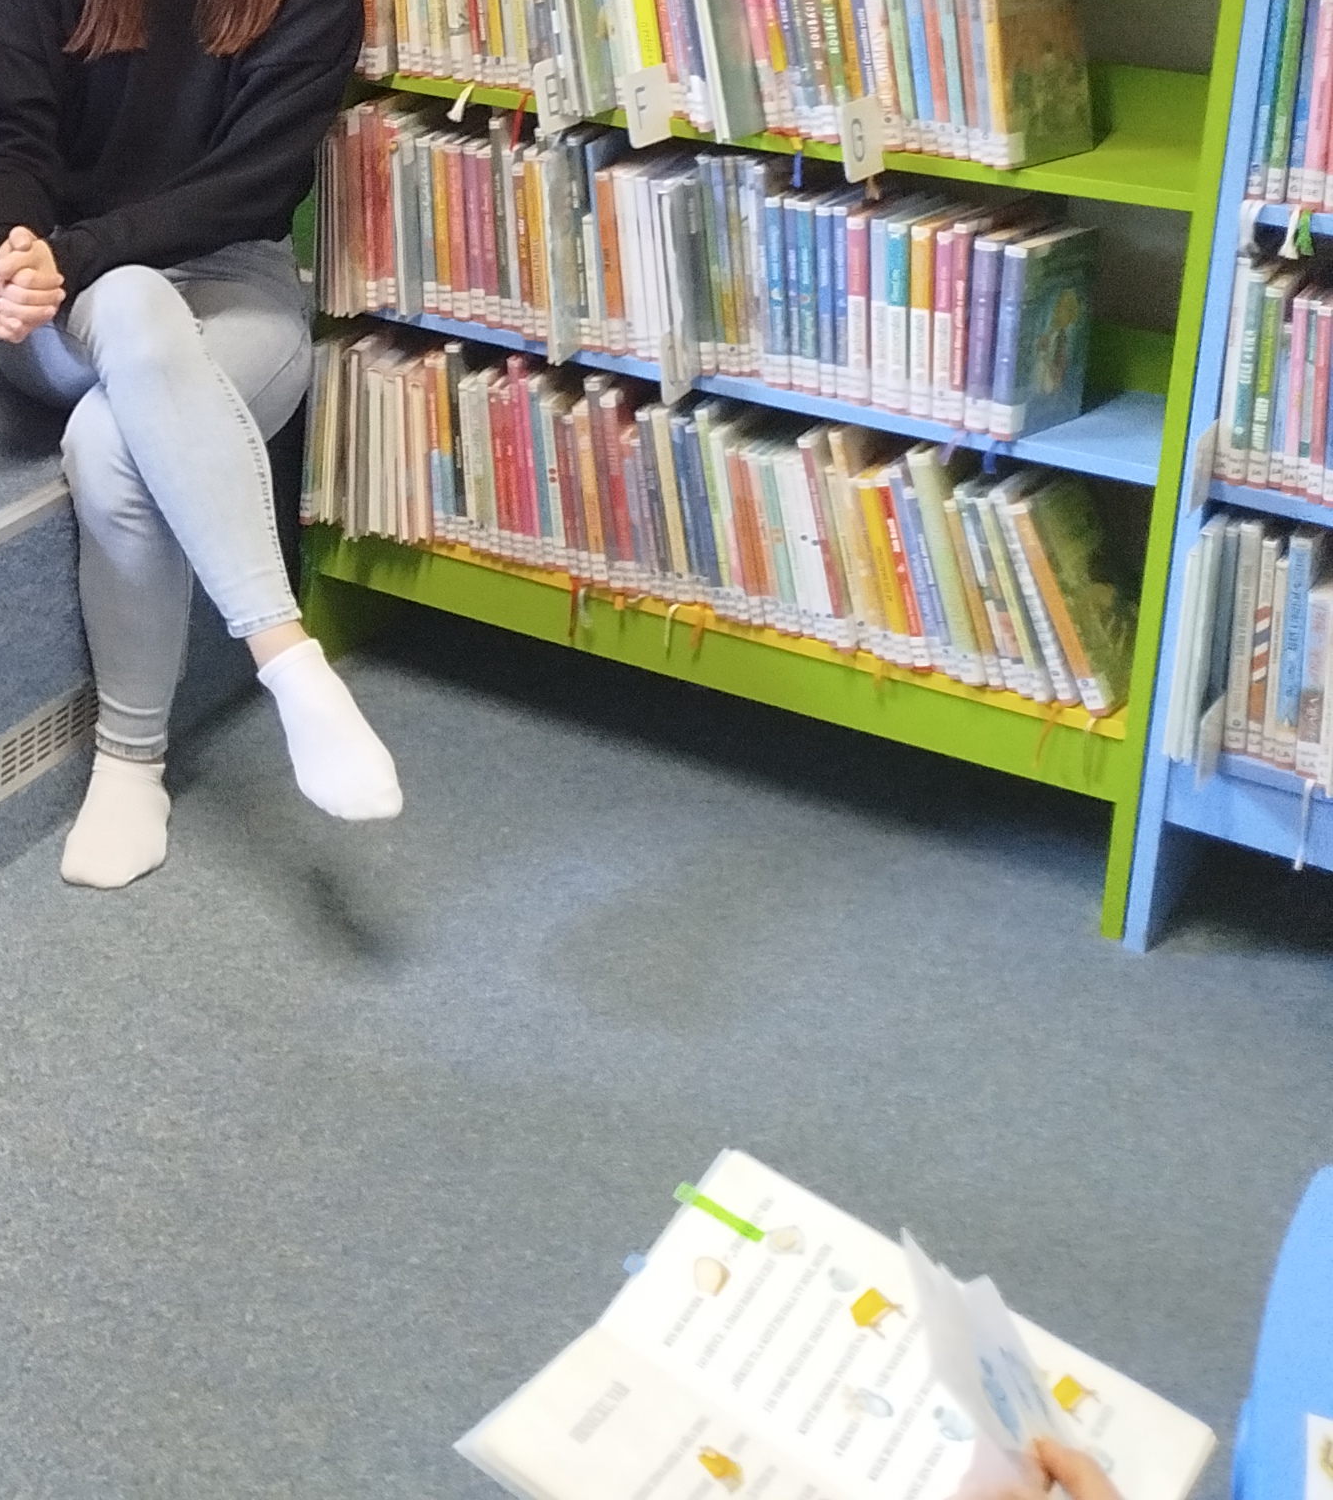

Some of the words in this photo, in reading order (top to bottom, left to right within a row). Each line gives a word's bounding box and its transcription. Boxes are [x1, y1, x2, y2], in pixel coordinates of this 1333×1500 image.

[545, 73, 561, 117] E
[634, 85, 647, 130] F
[851, 117, 865, 163] G
